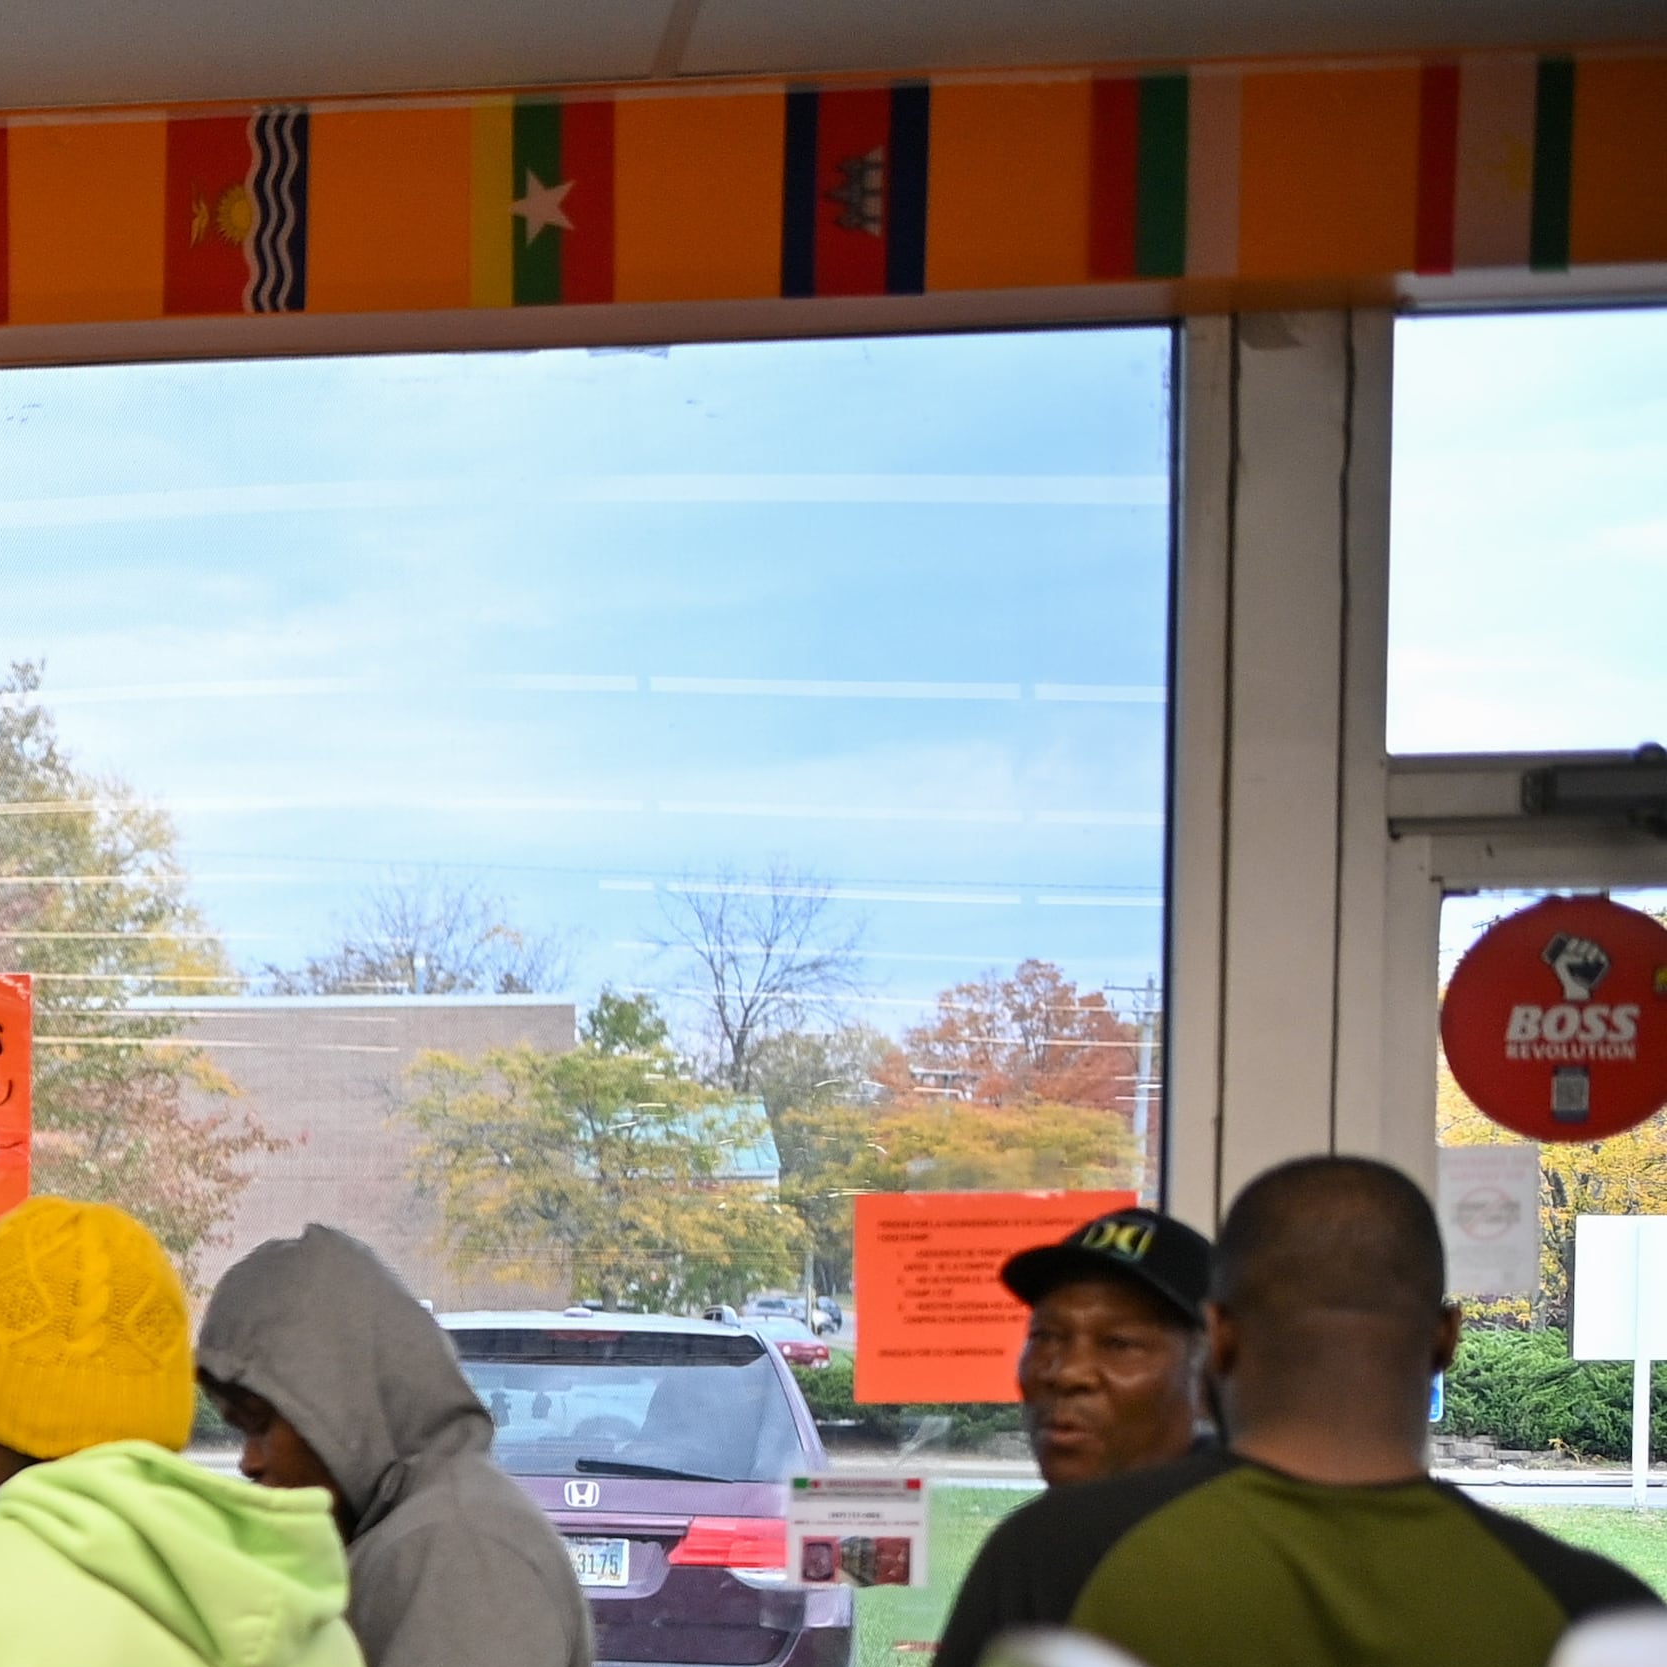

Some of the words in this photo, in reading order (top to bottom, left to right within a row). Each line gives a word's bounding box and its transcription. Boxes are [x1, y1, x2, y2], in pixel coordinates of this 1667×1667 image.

[1506, 1004, 1640, 1040] BOSS
[1505, 1041, 1637, 1061] REVOLUTION
[577, 1553, 618, 1576] 3175
